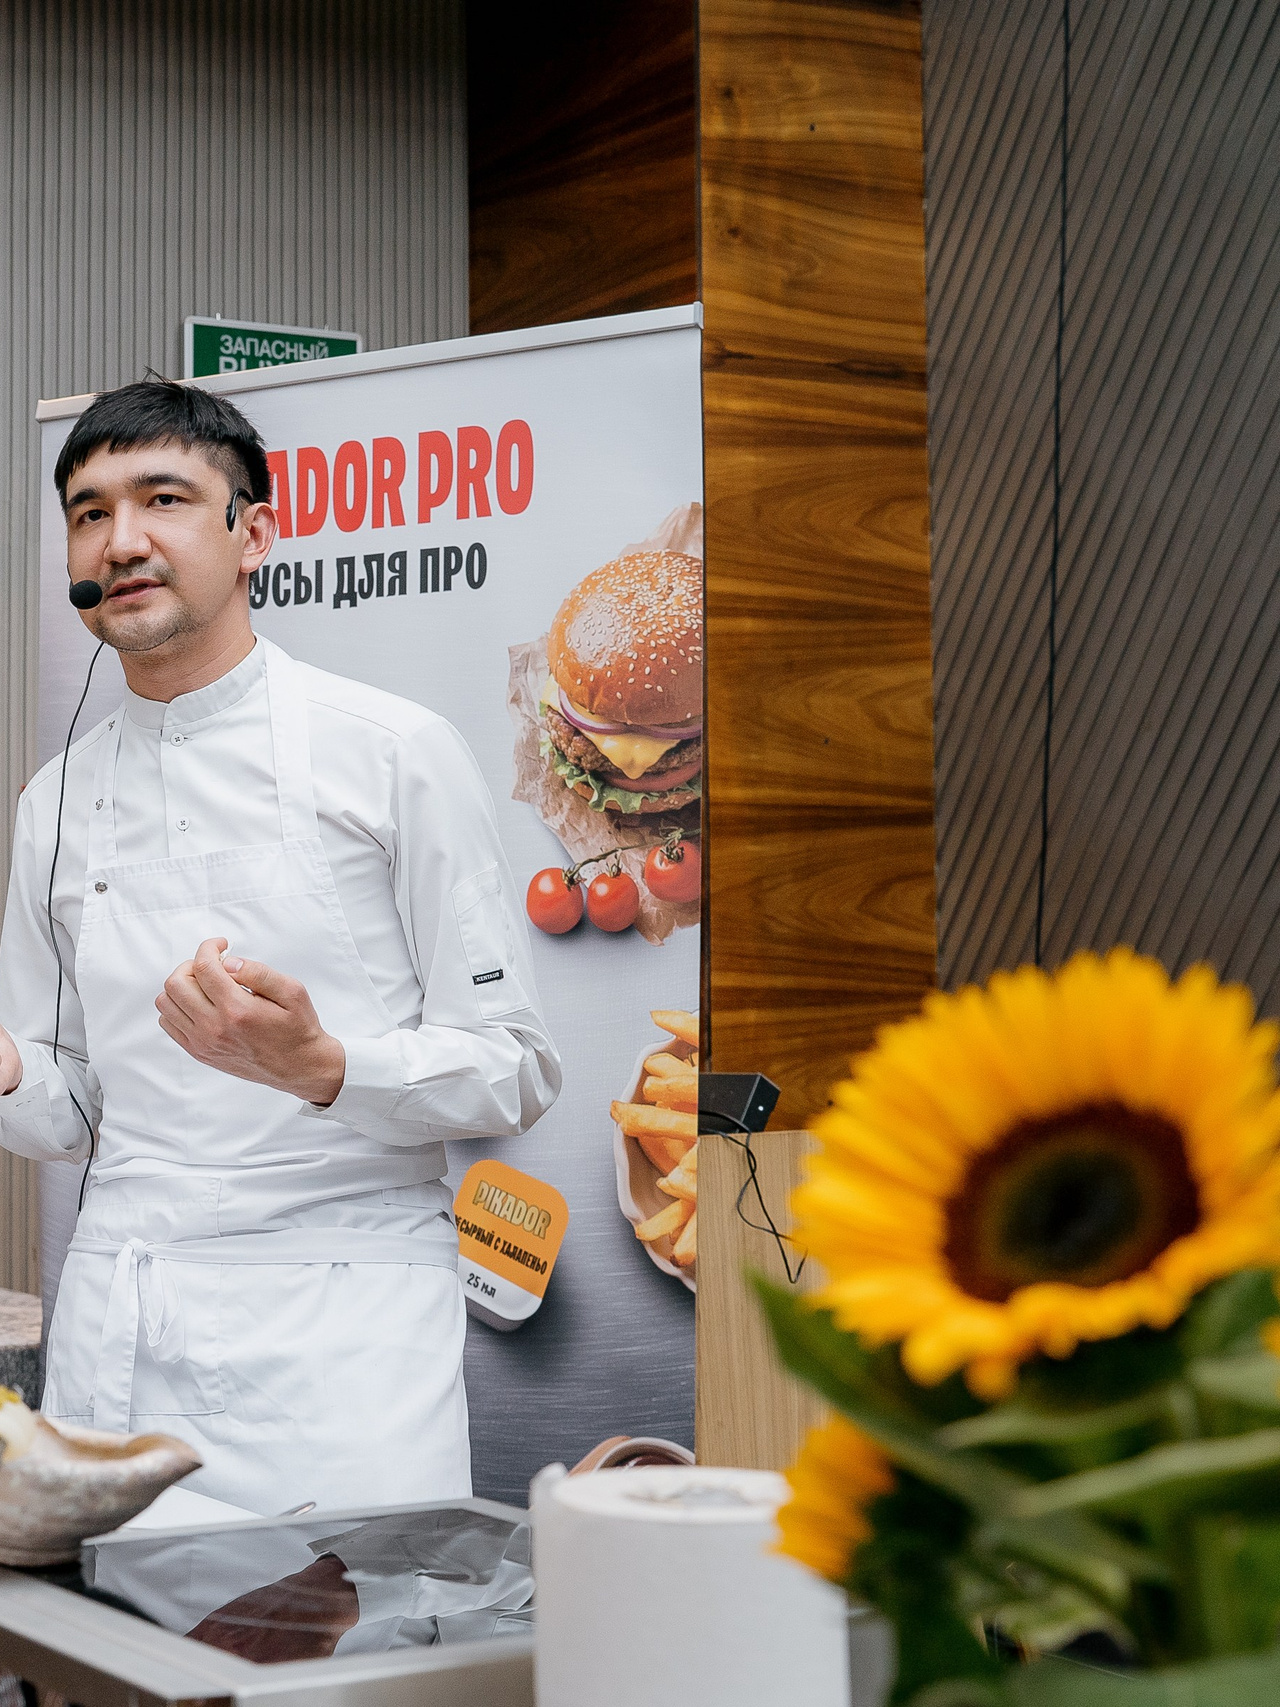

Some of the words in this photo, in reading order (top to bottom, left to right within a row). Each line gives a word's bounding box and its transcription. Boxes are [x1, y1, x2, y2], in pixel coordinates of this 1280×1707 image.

[220, 334, 329, 361] ЗАПАСНЫЙ
[417, 419, 534, 525] PRO
[332, 551, 408, 610] ДЛЯ
[419, 542, 488, 594] ПРО
[473, 1179, 552, 1240] PIKADOR
[460, 1219, 495, 1247] СЫРНЫЙ
[493, 1237, 501, 1251] С
[500, 1240, 548, 1275] ХАЛАПЕНЬО
[467, 1273, 481, 1289] 25
